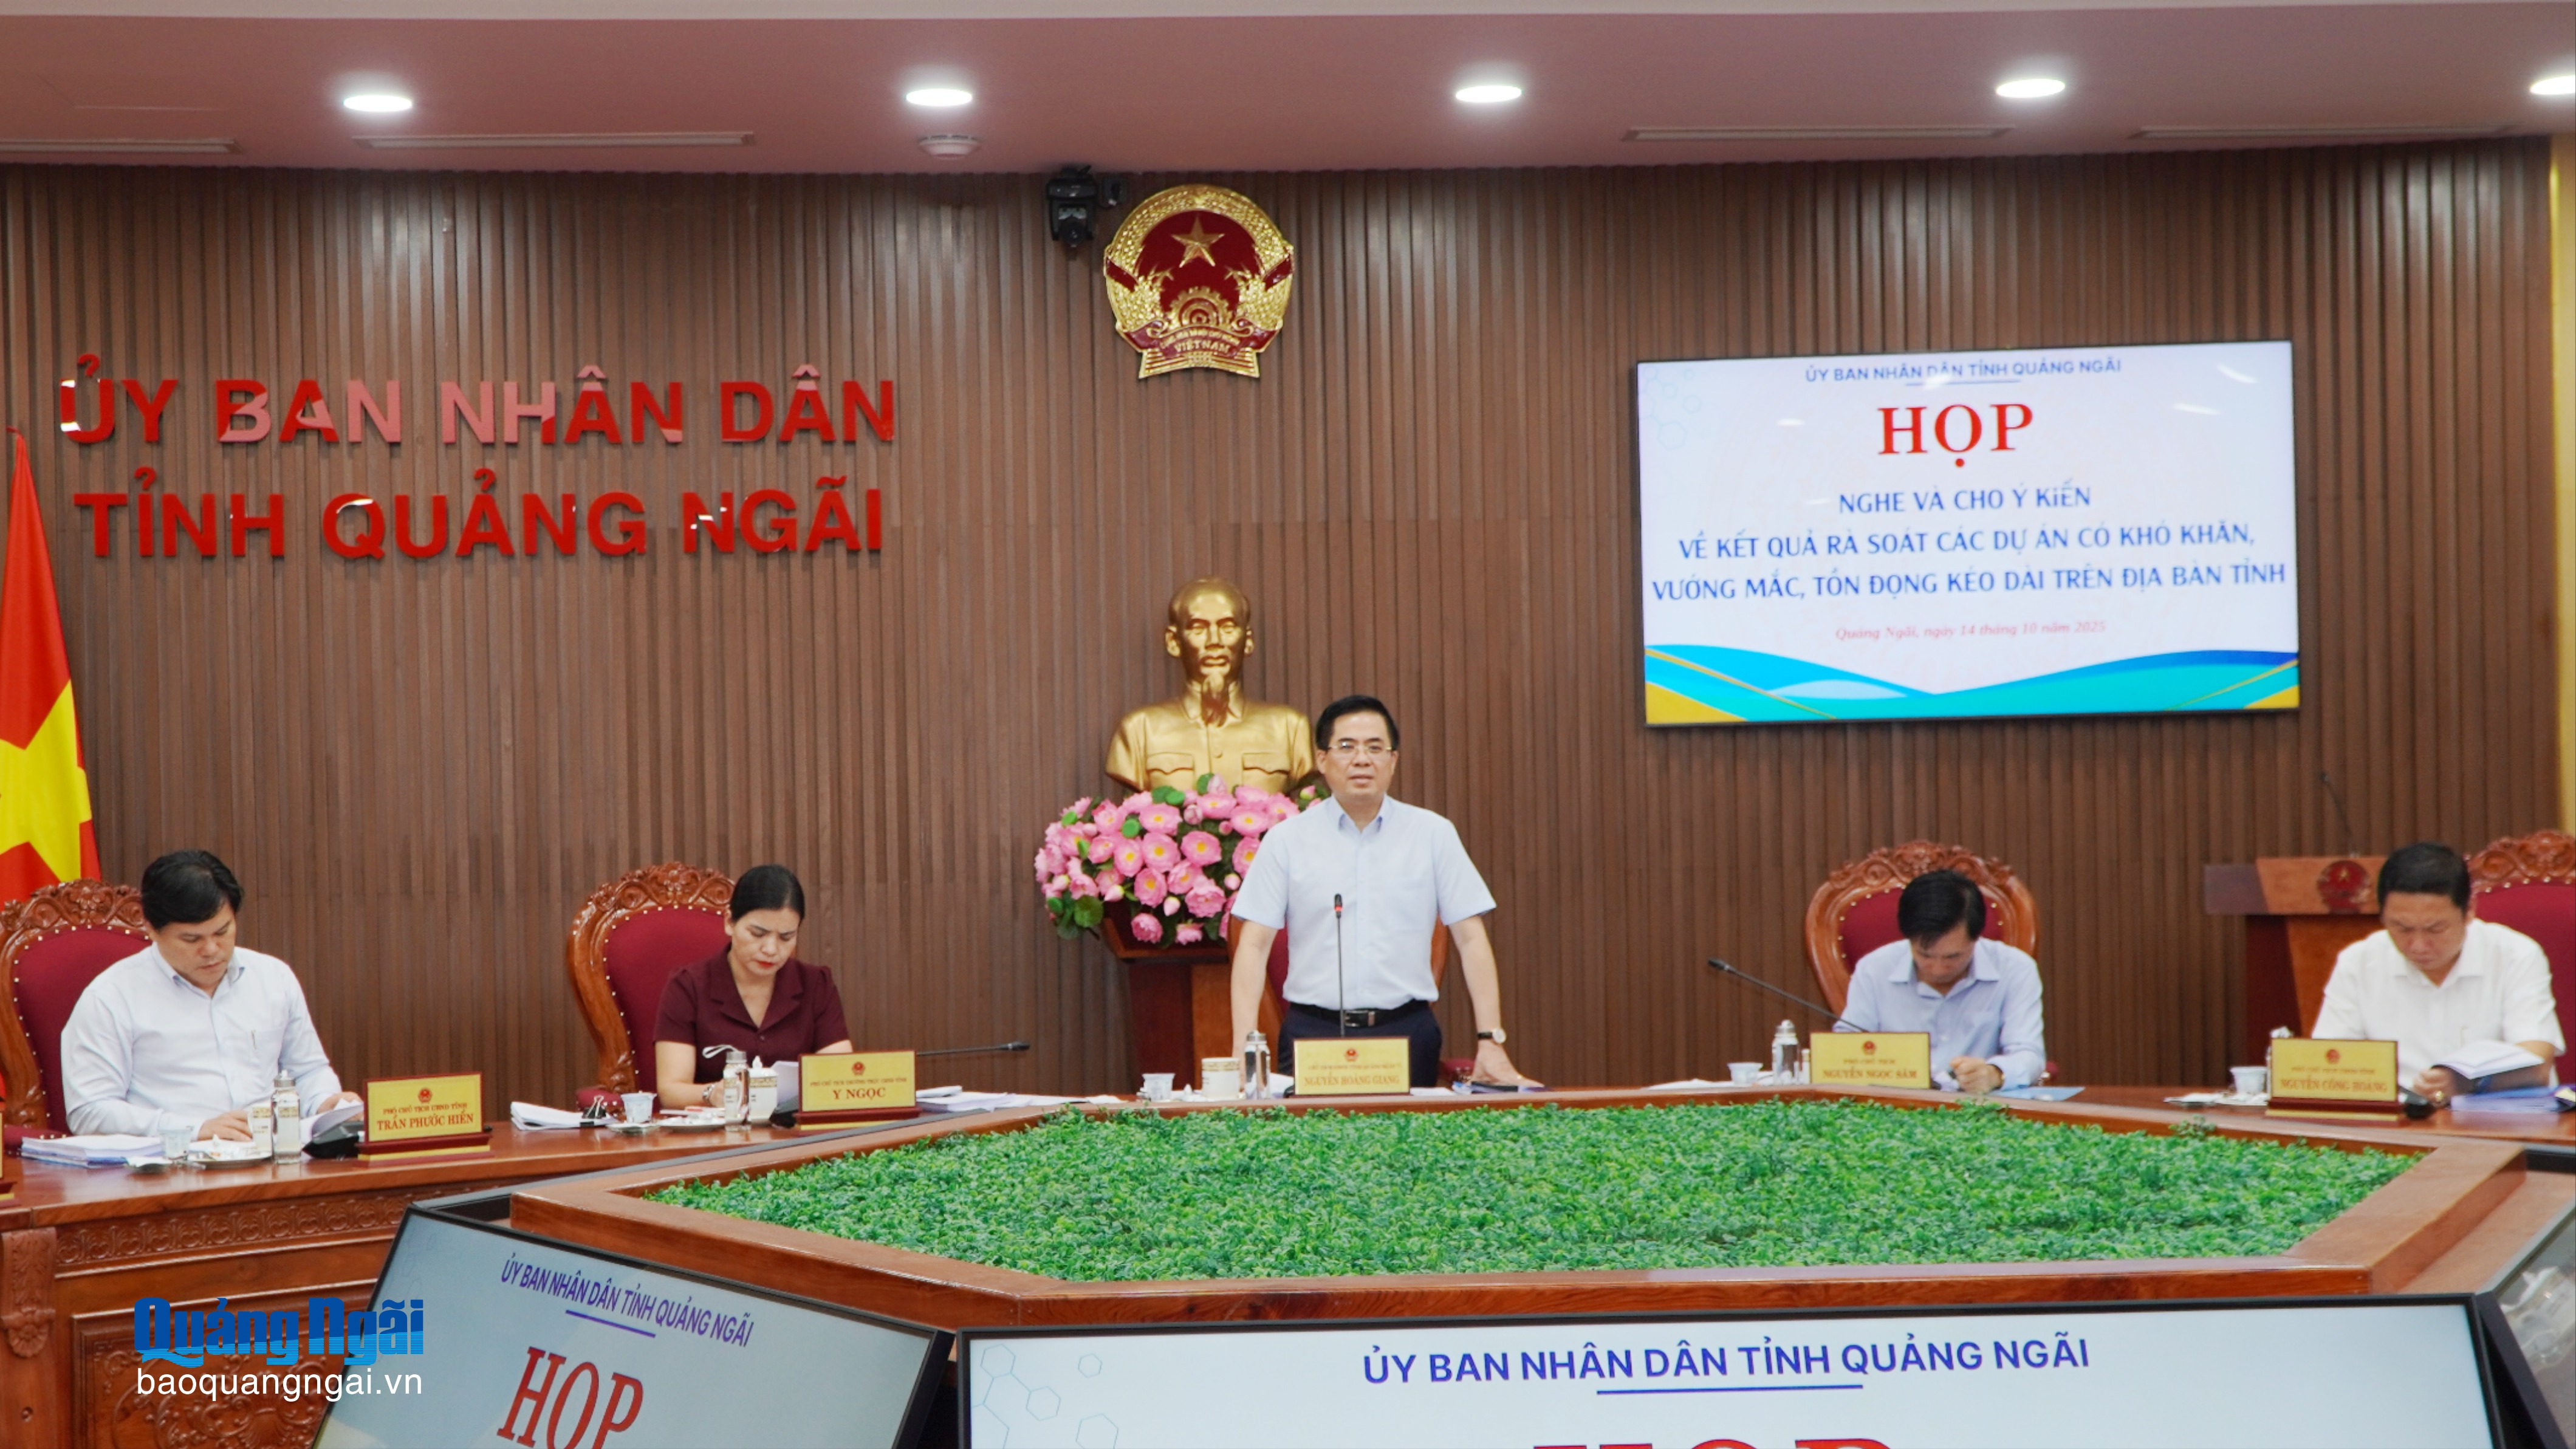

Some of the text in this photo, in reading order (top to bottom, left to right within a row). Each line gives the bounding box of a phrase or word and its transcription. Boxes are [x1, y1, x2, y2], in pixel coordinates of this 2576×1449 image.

[1806, 365, 1828, 382] ỦY
[1834, 368, 1869, 381] BAN
[1873, 363, 1922, 380] NHÂN
[1968, 359, 2007, 377] TỈNH
[2013, 358, 2075, 375] QUẢNG
[2080, 356, 2121, 373] NGÃI
[60, 354, 895, 444] ỦY BAN NHÂN DÂN
[1878, 403, 2033, 468] HỌP
[74, 467, 883, 560] TỈNH QUẢNG NGÃI
[1839, 492, 1905, 513] NGHE
[1913, 485, 1945, 511] VÀ
[1954, 489, 2004, 511] CHO
[2012, 483, 2028, 508] Ý
[1717, 528, 1759, 558] KẾT
[1767, 529, 1818, 558] QUẢ
[1827, 529, 1858, 555] RÀ
[1867, 526, 1928, 554] SOÁT
[1936, 524, 1985, 552] CÁC
[1993, 529, 2027, 555] DỰ
[2034, 522, 2068, 548] ÁN
[2078, 521, 2110, 547] CÓ
[2120, 519, 2171, 546] KHÓ
[2180, 520, 2255, 545] KHĂN,
[1653, 557, 2286, 600] VƯỚNG MẮC, TỒN ĐỌNG KÉO DÀI TRÊN ĐỊA BÀN TỈNH
[1961, 625, 1975, 636] 14
[2022, 622, 2036, 634] 10
[2074, 620, 2106, 633] 2025
[833, 1088, 886, 1101] Y NGỌC
[1372, 1075, 1400, 1085] GIANG
[409, 1113, 446, 1128] PHƯỚC
[501, 1253, 755, 1348] ỦY BAN NHÂN DÂN TỈNH QUẢNG NGÃI
[1363, 1331, 2089, 1384] ỦY BAN NHÂN DÂN TỈNH QUẢNG NGÃI
